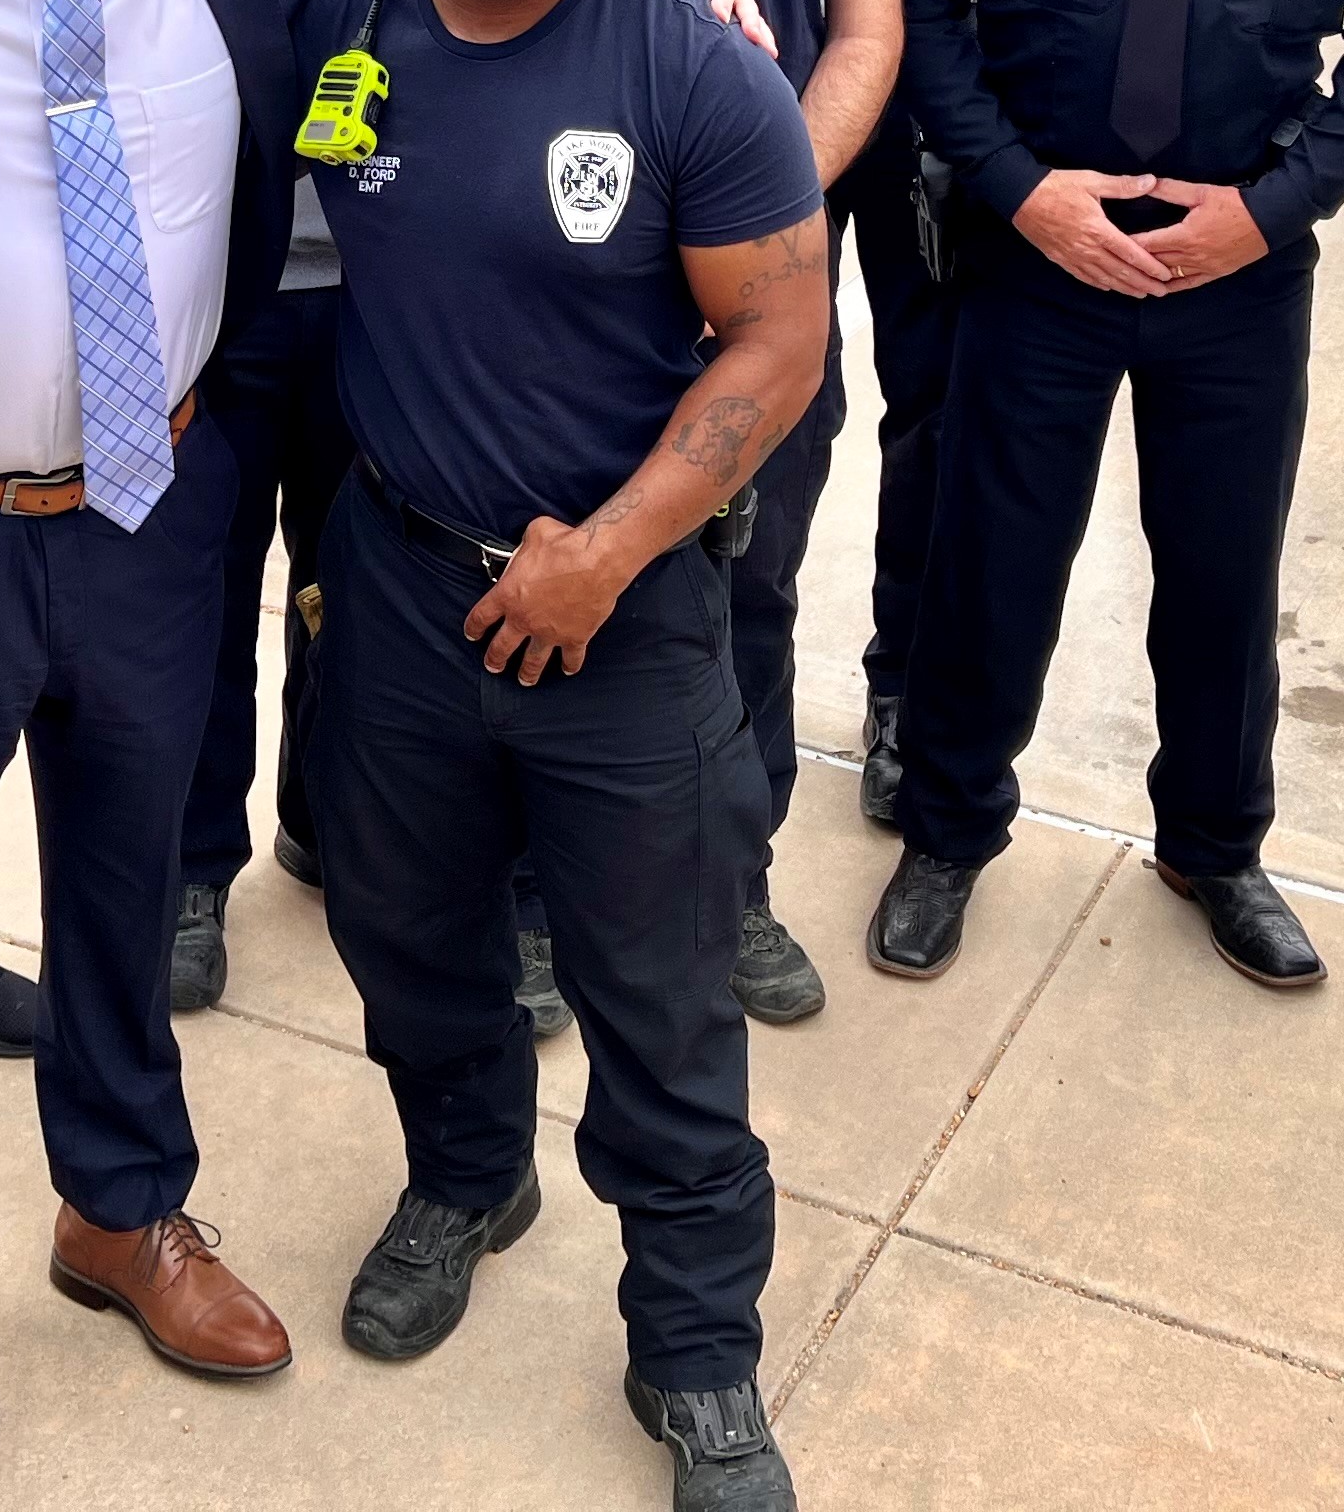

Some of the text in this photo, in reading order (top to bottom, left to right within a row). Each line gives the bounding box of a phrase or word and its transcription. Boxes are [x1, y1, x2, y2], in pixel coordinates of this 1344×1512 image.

[363, 167, 396, 182] FORD
[358, 180, 384, 194] EMT
[574, 221, 600, 232] FIRE
